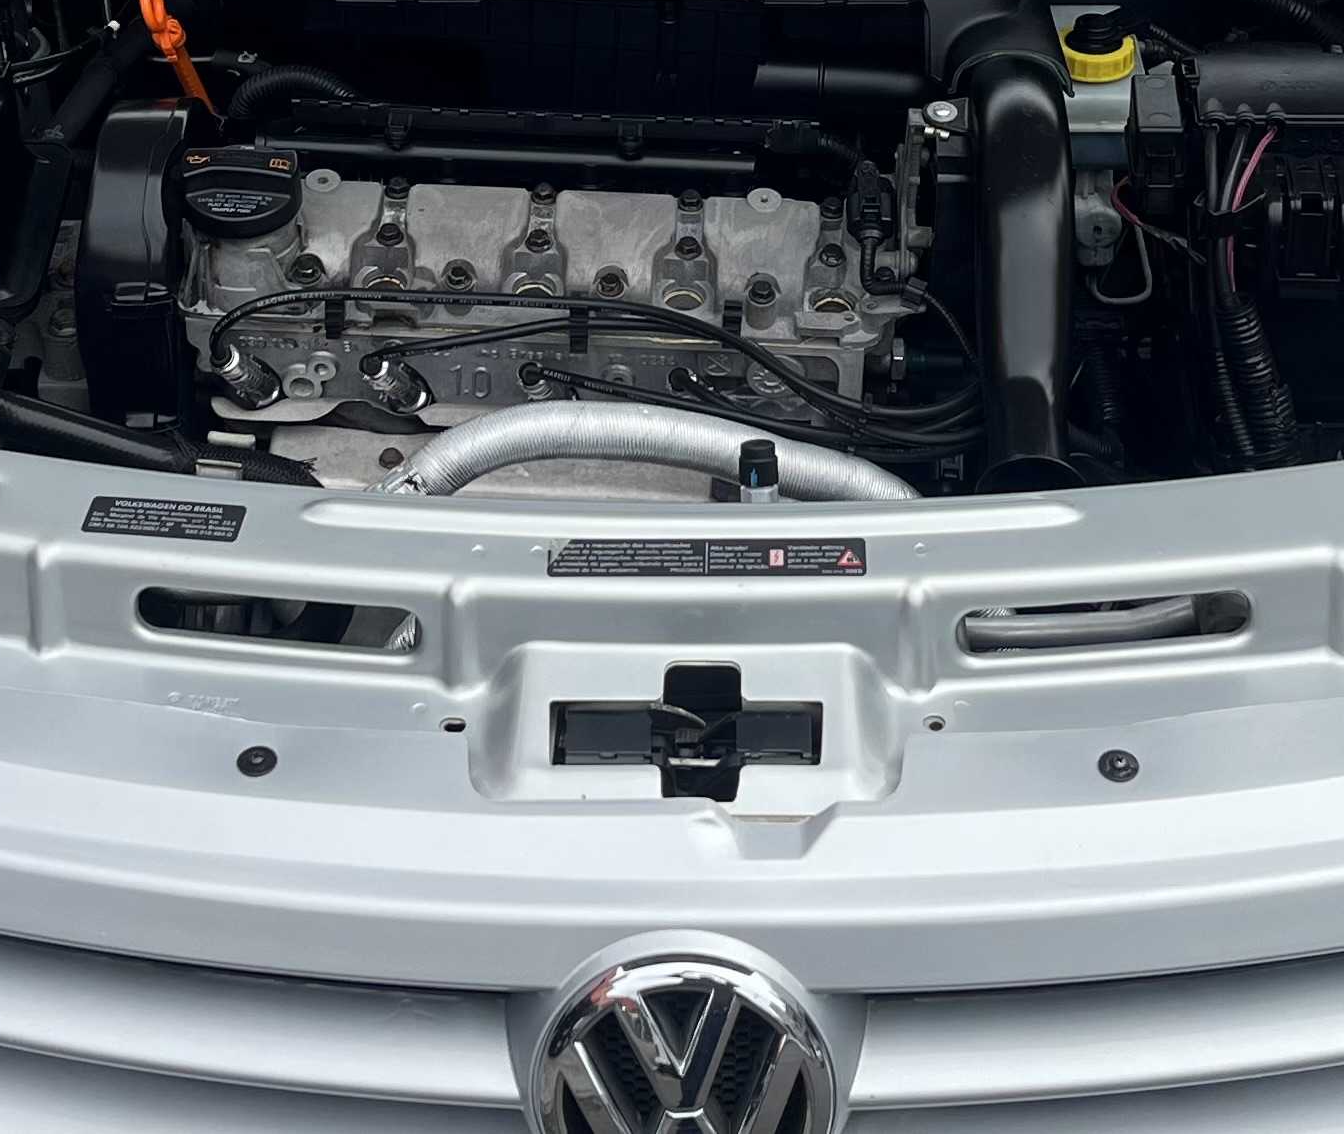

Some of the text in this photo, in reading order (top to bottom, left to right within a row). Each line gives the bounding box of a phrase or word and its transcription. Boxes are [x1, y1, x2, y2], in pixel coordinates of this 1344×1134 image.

[450, 364, 491, 398] 1.0
[114, 500, 176, 510] VOLKSWAGEN
[194, 506, 224, 514] BRASIL
